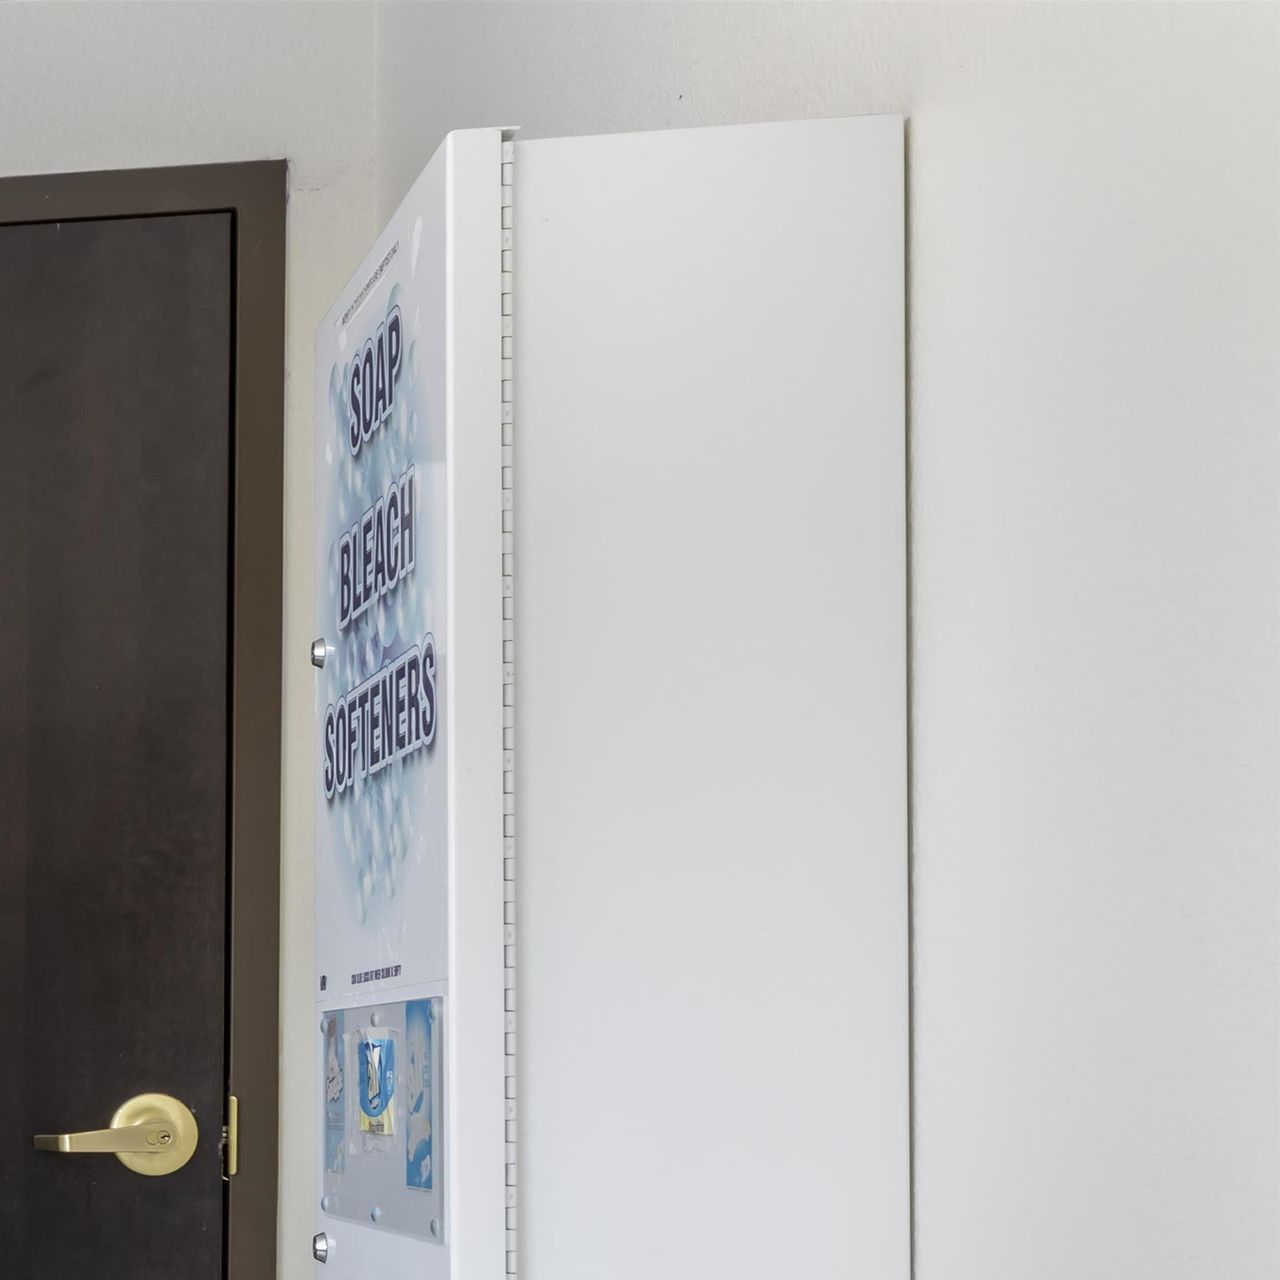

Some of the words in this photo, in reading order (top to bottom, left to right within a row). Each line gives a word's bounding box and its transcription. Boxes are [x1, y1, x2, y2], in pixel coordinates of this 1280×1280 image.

[350, 309, 402, 452] SOAP
[340, 470, 414, 627] BLEACH
[324, 636, 435, 797] SOFTENERS
